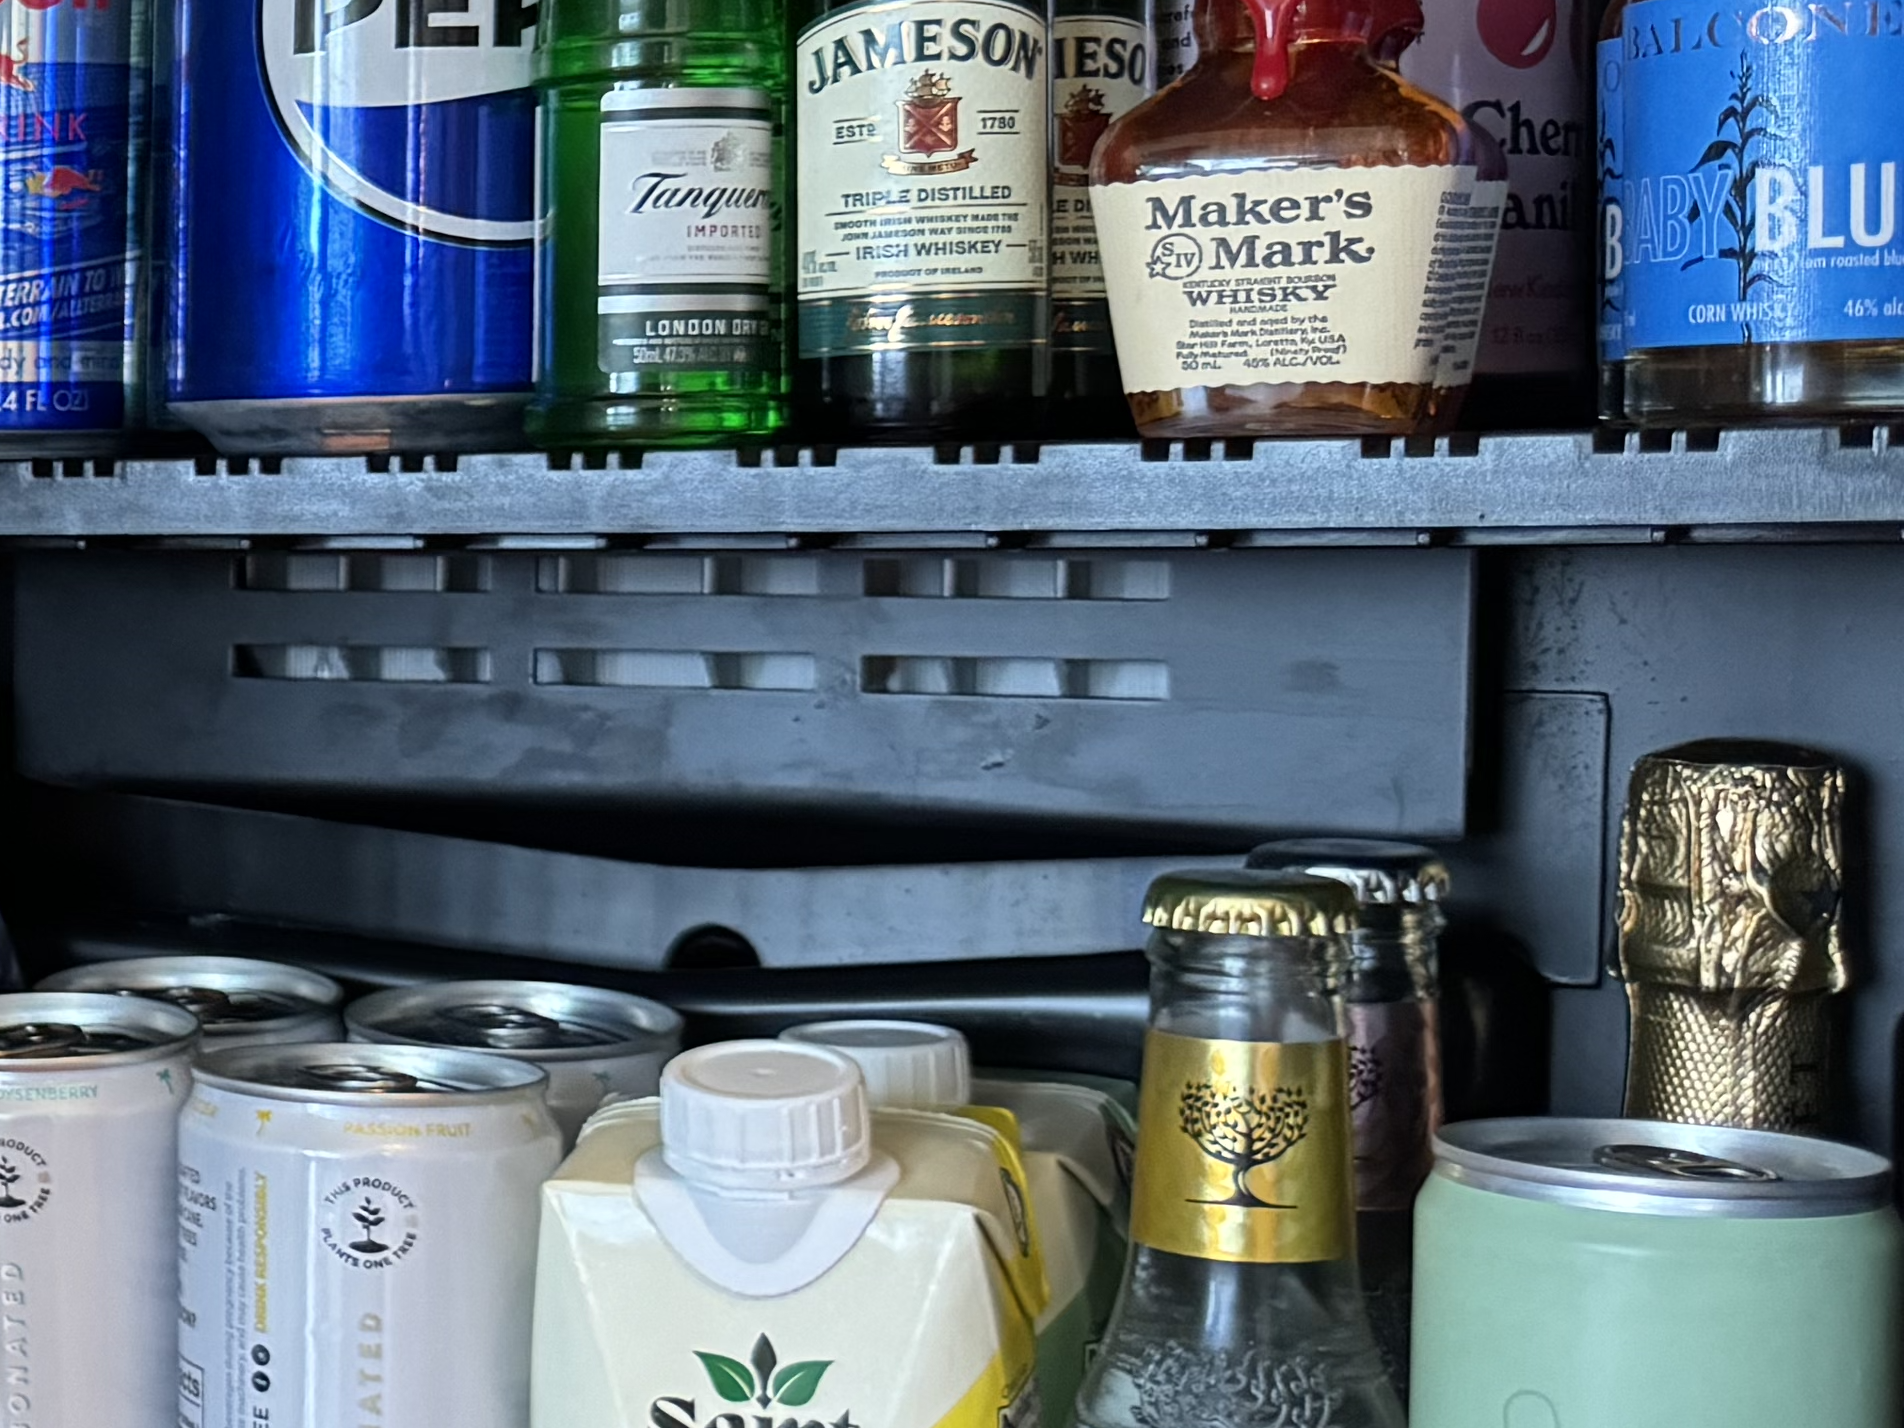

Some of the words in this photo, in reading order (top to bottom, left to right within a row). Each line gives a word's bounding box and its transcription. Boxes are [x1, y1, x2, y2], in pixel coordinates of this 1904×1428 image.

[1627, 0, 1903, 61] BALCONE
[808, 18, 1039, 95] JAMESON
[981, 116, 1016, 130] 1780
[625, 172, 770, 219] Tanquer
[841, 189, 910, 208] TRIPLE
[917, 186, 1012, 204] DISTILLED
[1144, 188, 1373, 231] Maker's
[1623, 171, 1733, 265] BABY
[1755, 161, 1896, 250] BLU
[686, 225, 761, 238] IMPORTED
[855, 243, 909, 261] IRISH
[913, 240, 1002, 258] WHISKEY
[1208, 230, 1376, 270] Mark
[1831, 253, 1879, 269] roasted
[1182, 284, 1337, 307] WHISKY
[1689, 305, 1726, 323] CORN
[1844, 299, 1878, 317] 46%
[645, 319, 726, 337] LONDON
[732, 319, 758, 336] DRY
[344, 1122, 421, 1137] PASSION
[426, 1122, 472, 1137] FRUIT
[323, 1180, 351, 1206] THIS
[353, 1176, 415, 1210] PRODUCT
[320, 1227, 360, 1269] PLANTS
[362, 1258, 393, 1270] ONE
[391, 1231, 418, 1261] TREE
